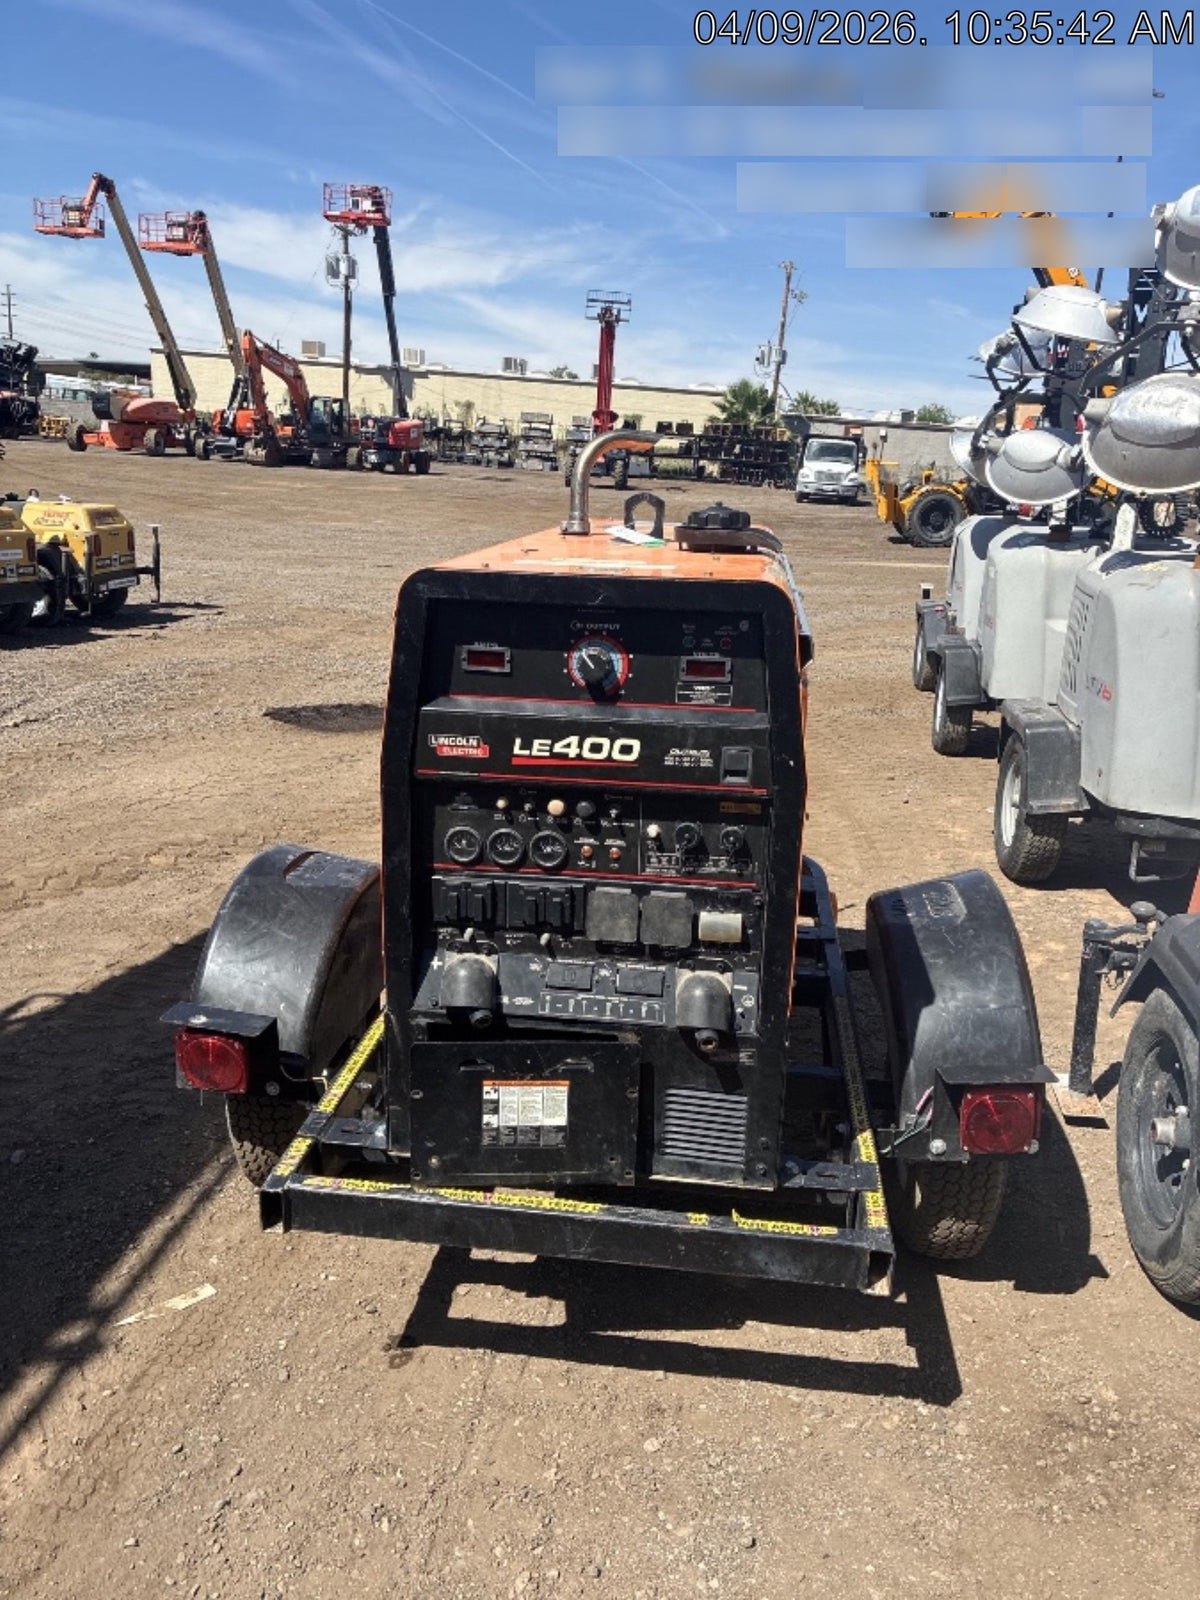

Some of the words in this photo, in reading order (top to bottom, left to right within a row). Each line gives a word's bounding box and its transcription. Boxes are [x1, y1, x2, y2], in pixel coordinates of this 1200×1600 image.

[431, 735, 478, 748] LINCOLN
[442, 746, 485, 756] ELECTRIC
[512, 735, 641, 762] LE400
